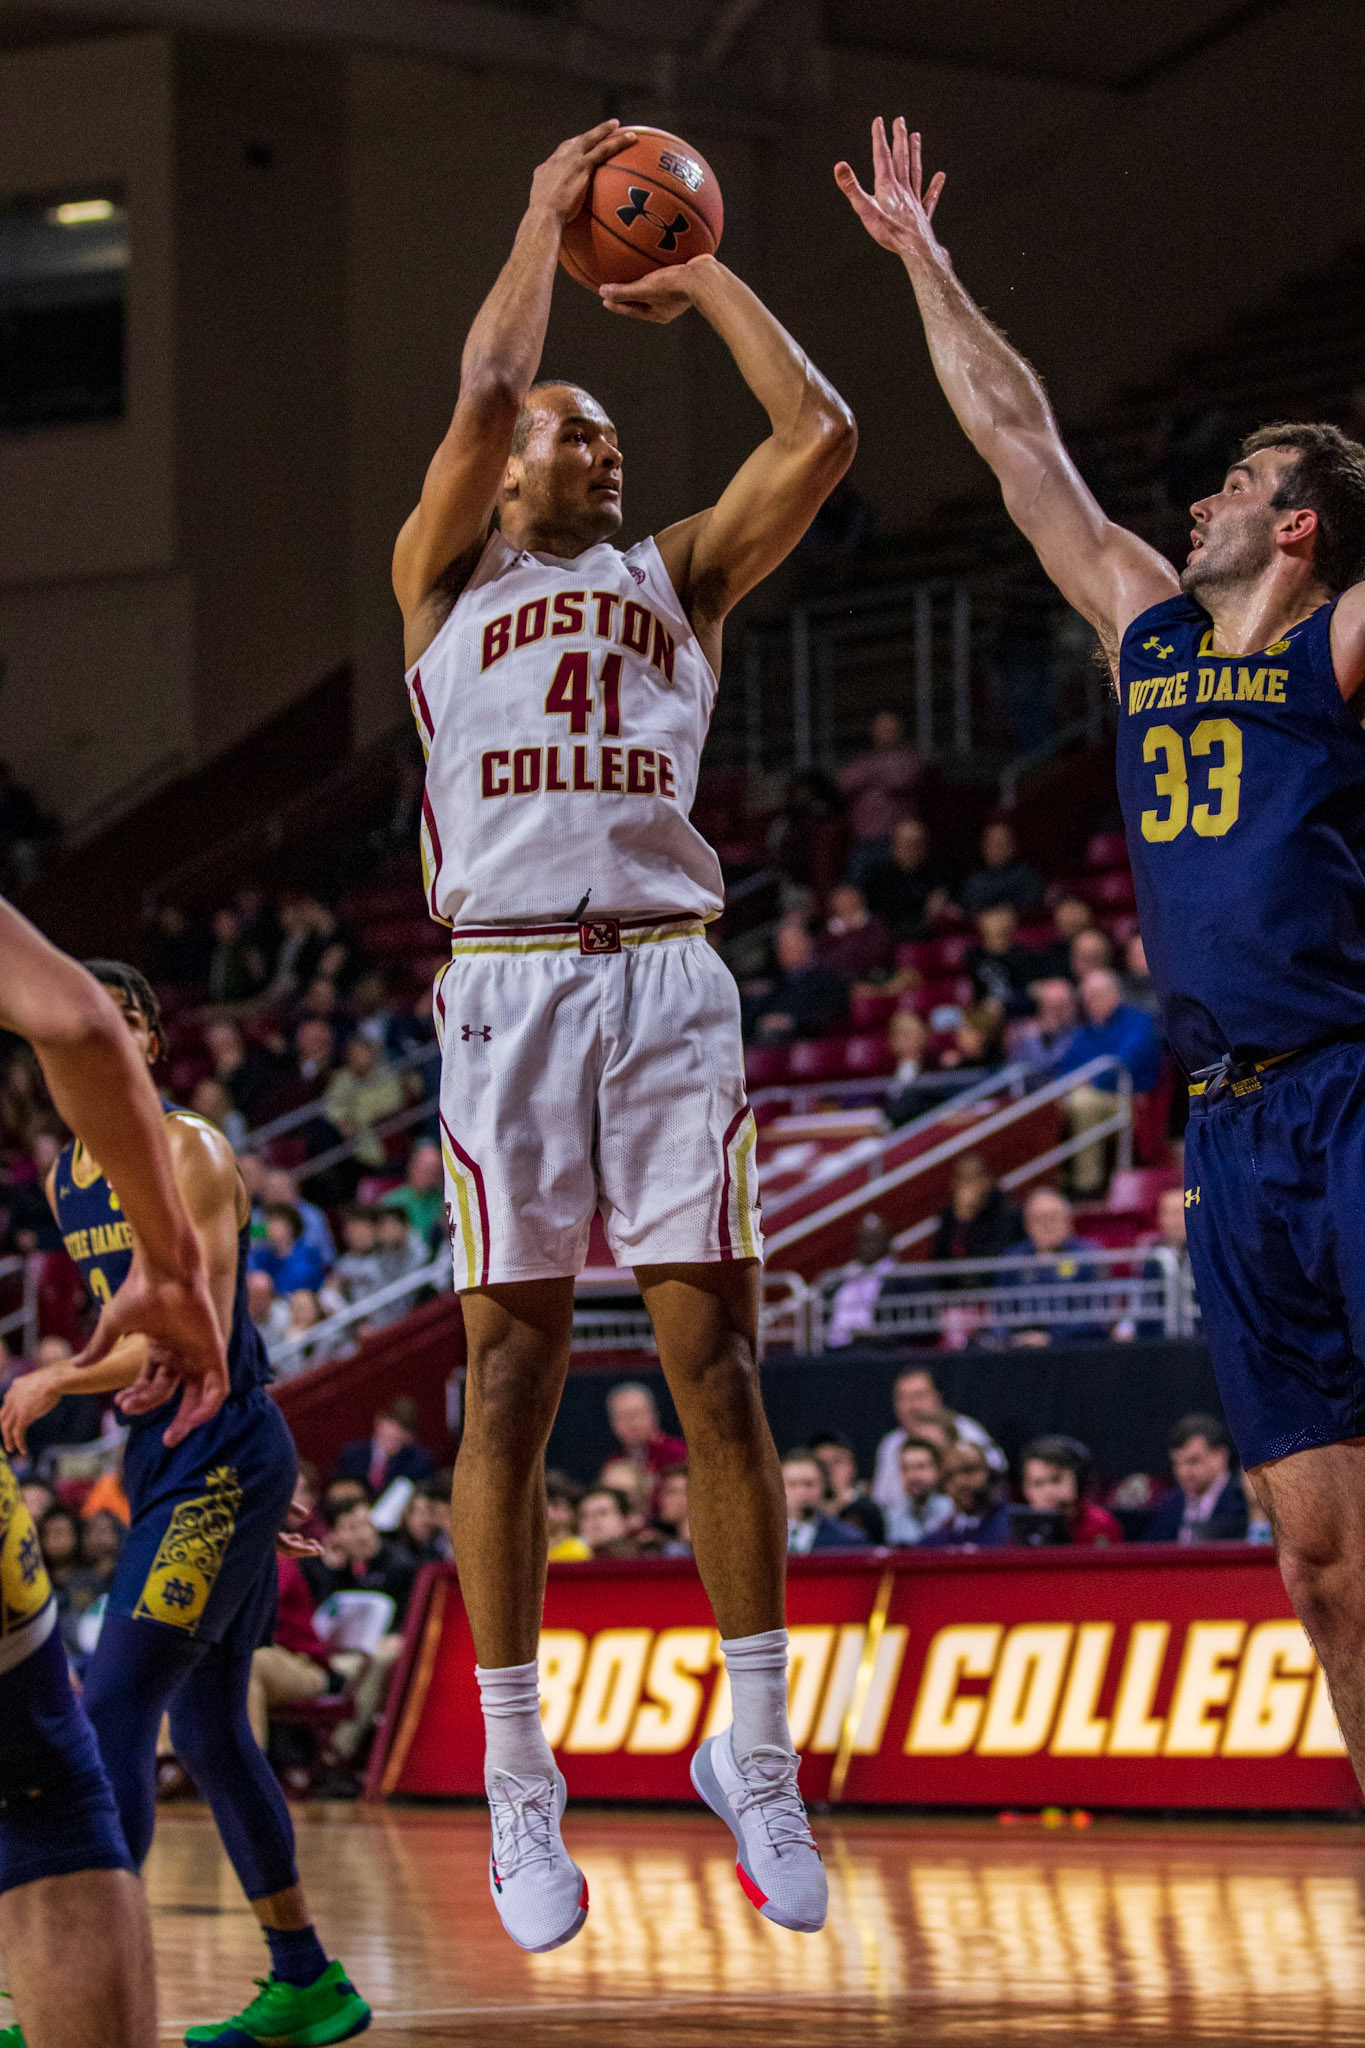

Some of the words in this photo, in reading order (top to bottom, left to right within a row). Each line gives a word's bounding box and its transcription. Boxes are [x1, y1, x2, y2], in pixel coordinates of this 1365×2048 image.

[480, 590, 676, 689] BOSTON
[544, 650, 624, 739] 41
[1128, 670, 1189, 717] NOTRE
[1195, 666, 1290, 704] DAME
[481, 745, 679, 800] COLLEGE
[1141, 718, 1243, 843] 33
